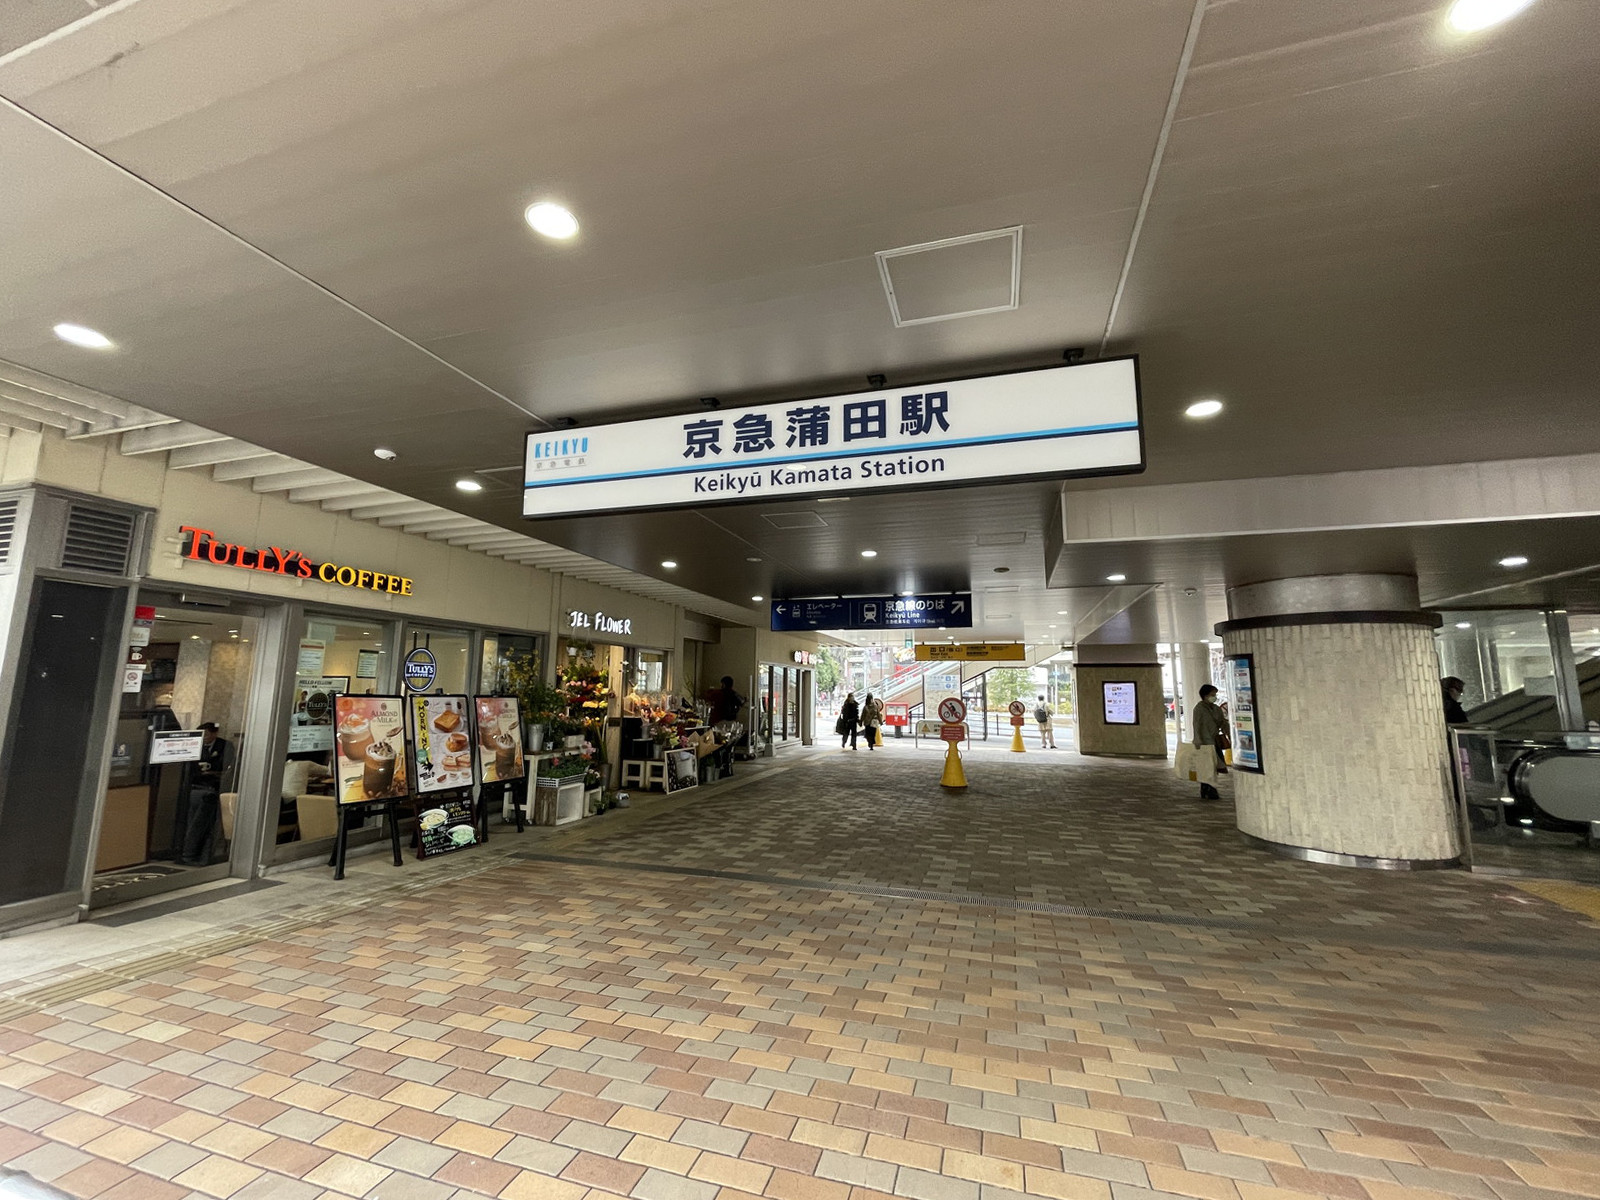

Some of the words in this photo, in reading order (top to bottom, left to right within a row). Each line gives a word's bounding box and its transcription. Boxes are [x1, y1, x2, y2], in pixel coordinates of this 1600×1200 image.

[683, 390, 950, 459] 京急蒲田駅
[534, 437, 588, 459] KEIKYU
[694, 471, 762, 494] Keikyū
[770, 465, 852, 486] Kamata
[860, 456, 945, 478] Station
[319, 562, 413, 597] COFFEE
[885, 600, 945, 612] 京急線のりば
[570, 611, 591, 627] JEL
[594, 611, 632, 635] FLOWER
[371, 710, 398, 718] ALMOND
